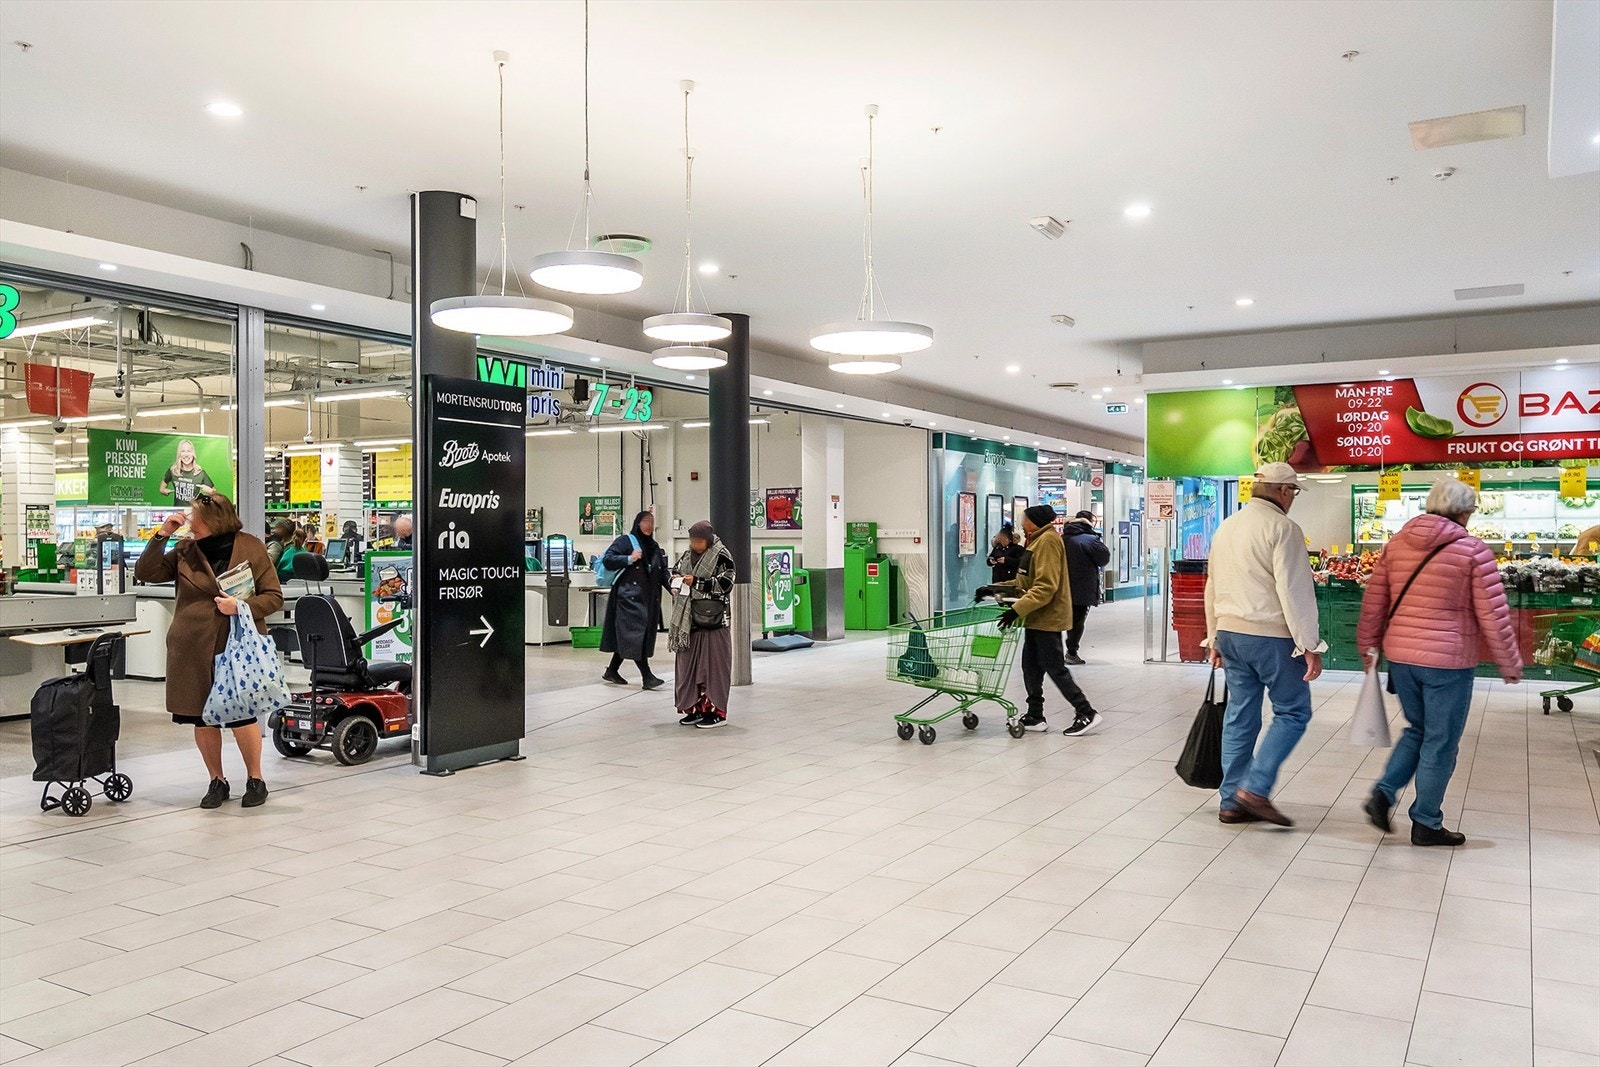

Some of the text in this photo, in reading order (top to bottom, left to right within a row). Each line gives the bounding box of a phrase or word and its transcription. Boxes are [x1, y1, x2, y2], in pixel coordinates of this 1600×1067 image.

[531, 365, 565, 389] mini
[1335, 386, 1393, 398] MAN-FRE
[436, 391, 522, 413] MORTENSRUDTORG
[531, 393, 560, 418] pris
[1348, 398, 1382, 409] 09-22
[1336, 411, 1389, 423] LØRDAG
[1348, 422, 1382, 433] 09-20
[115, 438, 138, 452] KIWI
[1336, 435, 1391, 447] SØNDAG
[1447, 442, 1497, 454] FRUKT
[1500, 441, 1524, 453] OG
[1526, 438, 1584, 452] GRØNT
[105, 451, 148, 466] PRESSER
[438, 440, 511, 469] Boots Apotek
[984, 449, 1006, 468] Europris
[1349, 447, 1382, 457] 10-20
[107, 465, 147, 479] PRISENE
[438, 487, 500, 514] Europris
[438, 521, 470, 549] ria
[439, 566, 520, 581] MAGIC TOUCH
[439, 585, 483, 600] FRISØR
